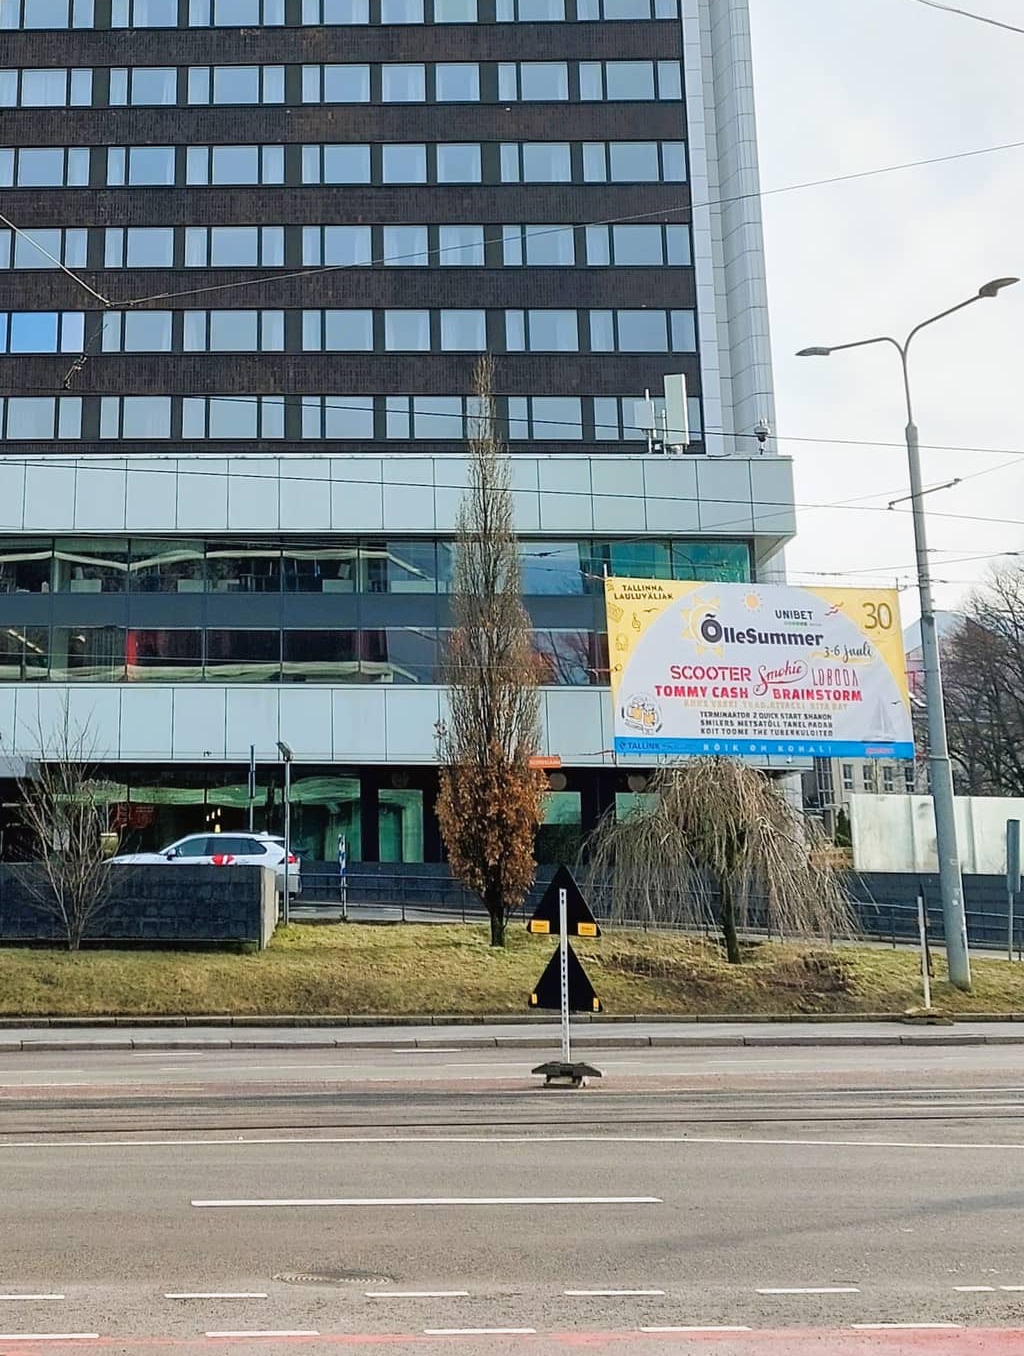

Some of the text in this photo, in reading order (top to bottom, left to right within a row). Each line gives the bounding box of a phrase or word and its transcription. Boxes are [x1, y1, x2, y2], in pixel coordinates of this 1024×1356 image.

[622, 584, 664, 592] TALLINNA
[775, 610, 814, 620] UNIBET
[862, 602, 893, 630] 30
[701, 613, 824, 646] ÕlleSummer
[670, 665, 751, 682] SCOOTER
[811, 668, 859, 686] LOBODA
[655, 685, 863, 702] TOMMY CASH BRAINSTORM
[700, 711, 750, 719] TERMINAATOR
